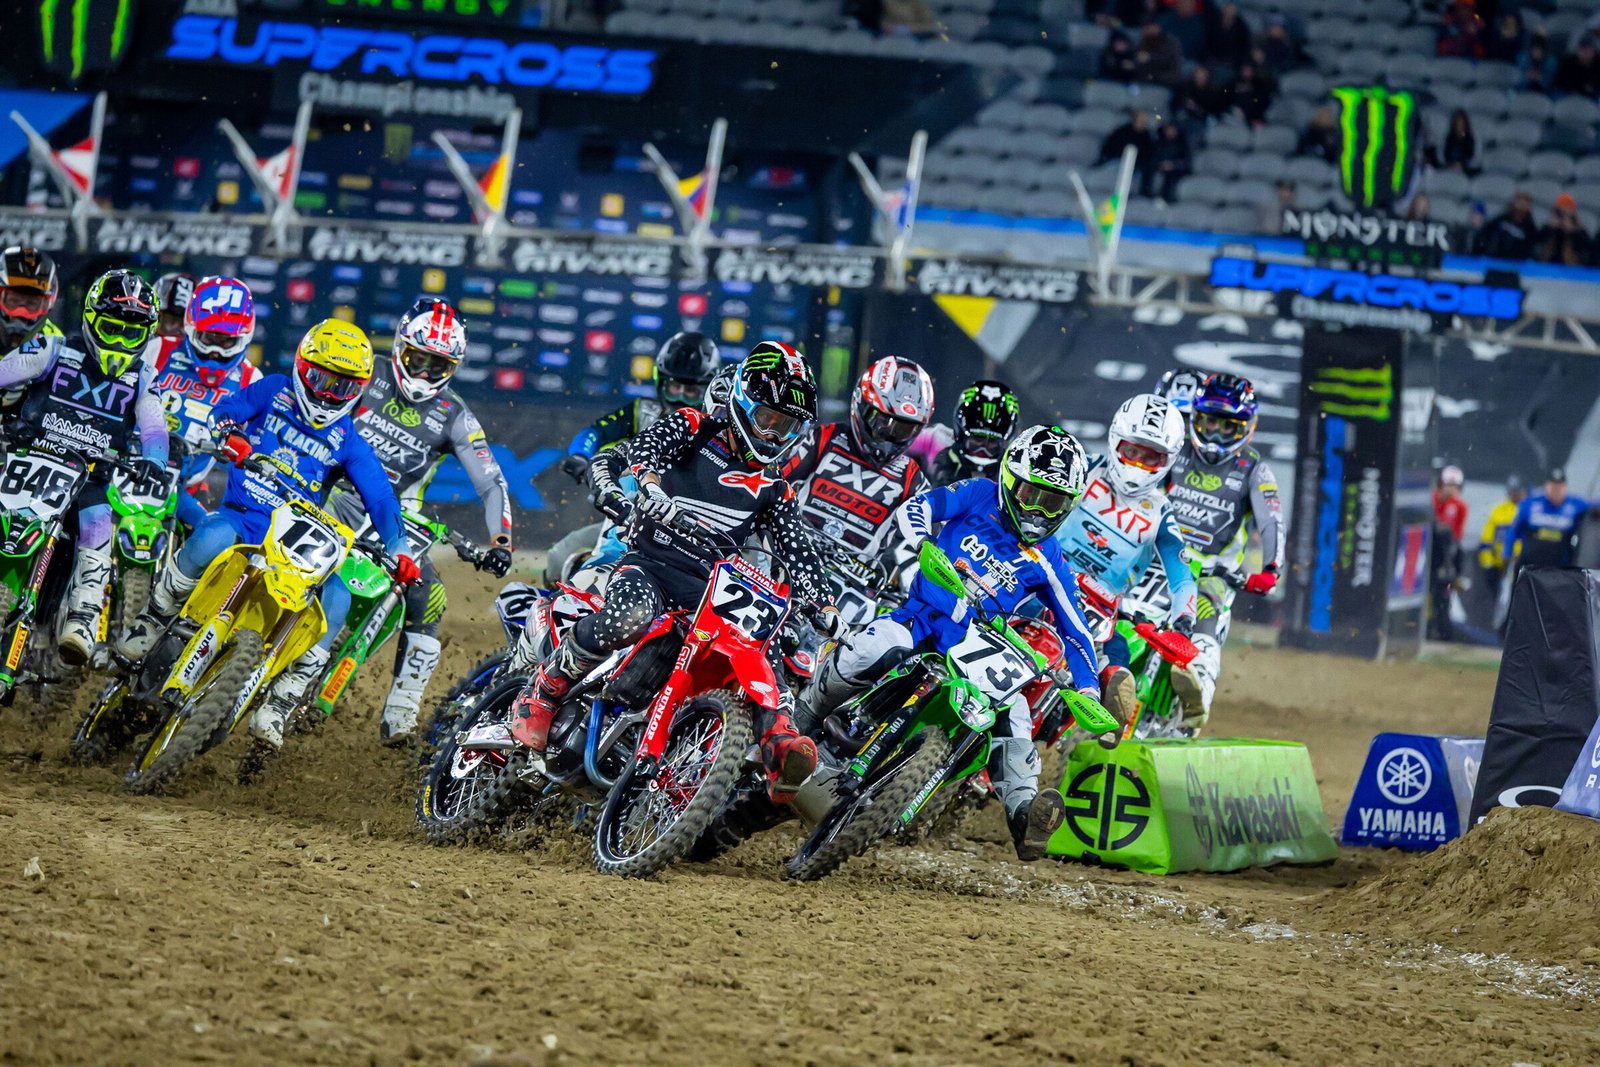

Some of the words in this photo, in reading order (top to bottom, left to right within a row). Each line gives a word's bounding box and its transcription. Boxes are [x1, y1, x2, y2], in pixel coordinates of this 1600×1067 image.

[166, 15, 657, 94] SUPERCROSS
[1283, 209, 1449, 250] MONSTER
[51, 366, 135, 415] FXR
[42, 412, 112, 449] NAMURA
[263, 413, 287, 435] FLY
[370, 416, 431, 453] PARTZILLA
[699, 447, 729, 470] SHOWA
[815, 451, 904, 507] FXR
[816, 483, 883, 519] MOTO
[1081, 479, 1153, 544] FXR
[1176, 486, 1236, 513] PARTZILLA
[735, 562, 775, 591] RENTHAL
[934, 566, 956, 587] CIRCUIT
[981, 560, 1017, 593] PARTS
[987, 554, 1019, 585] MADD
[711, 583, 778, 641] 23
[957, 632, 1024, 692] 73
[648, 685, 673, 741] DUNLOP
[889, 716, 906, 734] TOP
[1073, 700, 1097, 720] CIRCUIT
[1207, 776, 1303, 847] Kawasaki
[1358, 807, 1447, 835] YAMAHA
